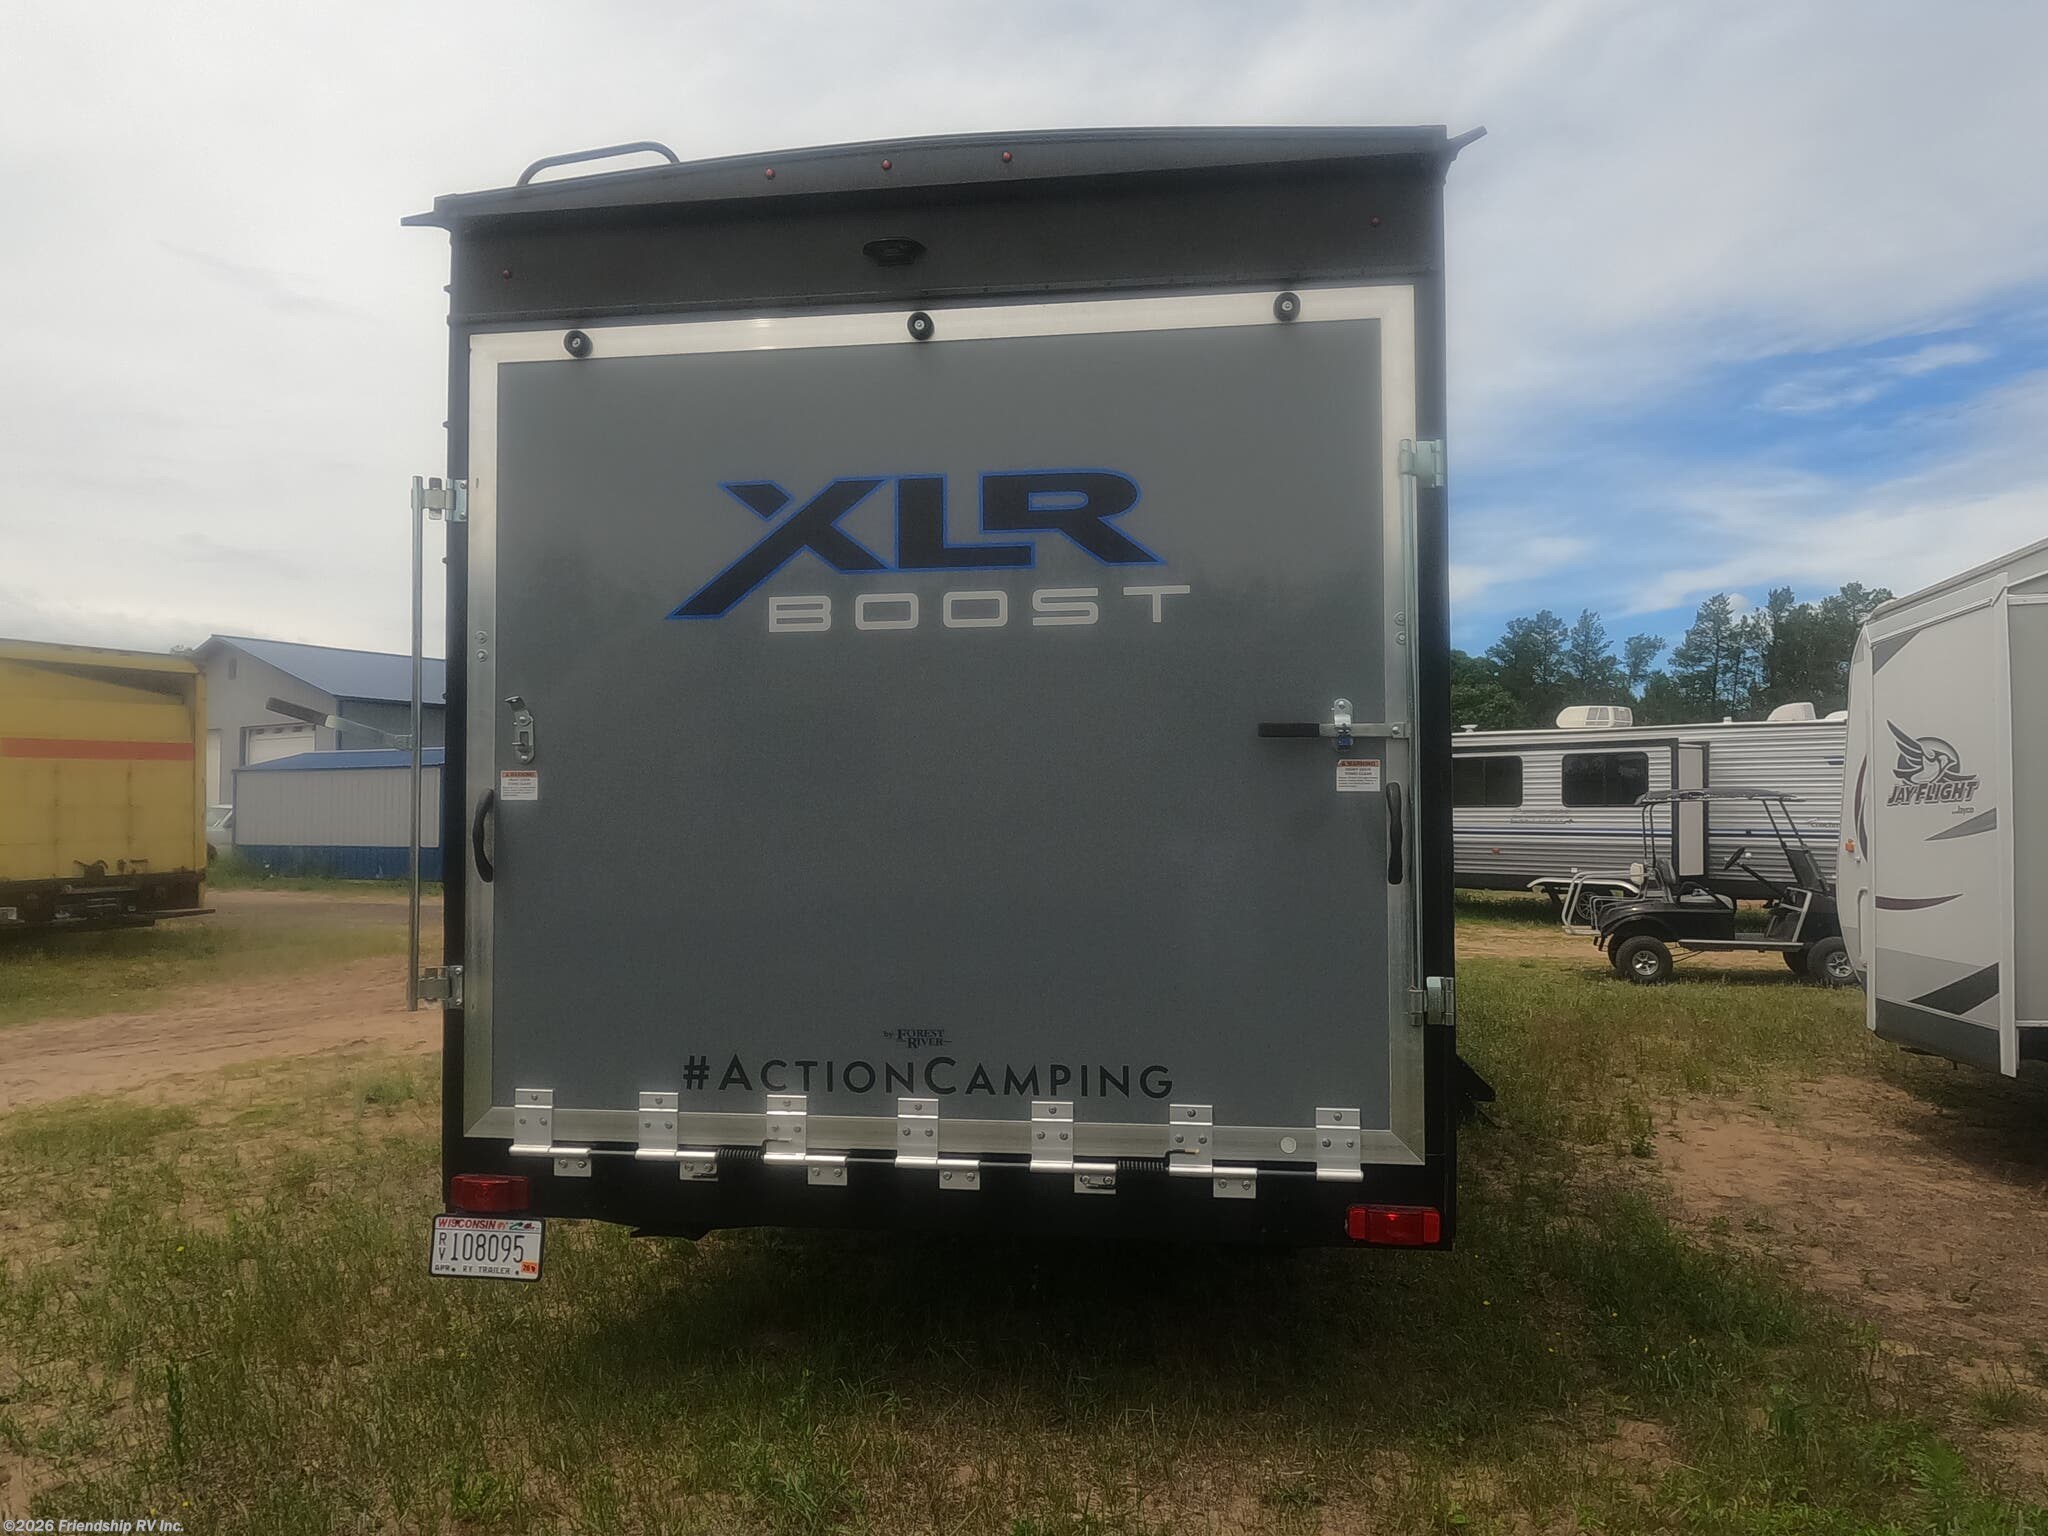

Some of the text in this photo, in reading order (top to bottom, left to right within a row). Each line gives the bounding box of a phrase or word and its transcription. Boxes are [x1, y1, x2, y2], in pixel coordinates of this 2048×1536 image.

[665, 467, 1167, 620] XLR
[768, 584, 1191, 633] BOOST
[897, 1029, 945, 1040] FOREST
[907, 1037, 944, 1049] RIVER
[438, 1218, 496, 1230] WISCONSIN
[450, 1233, 525, 1263] 108095
[478, 1266, 511, 1275] TRAILER
